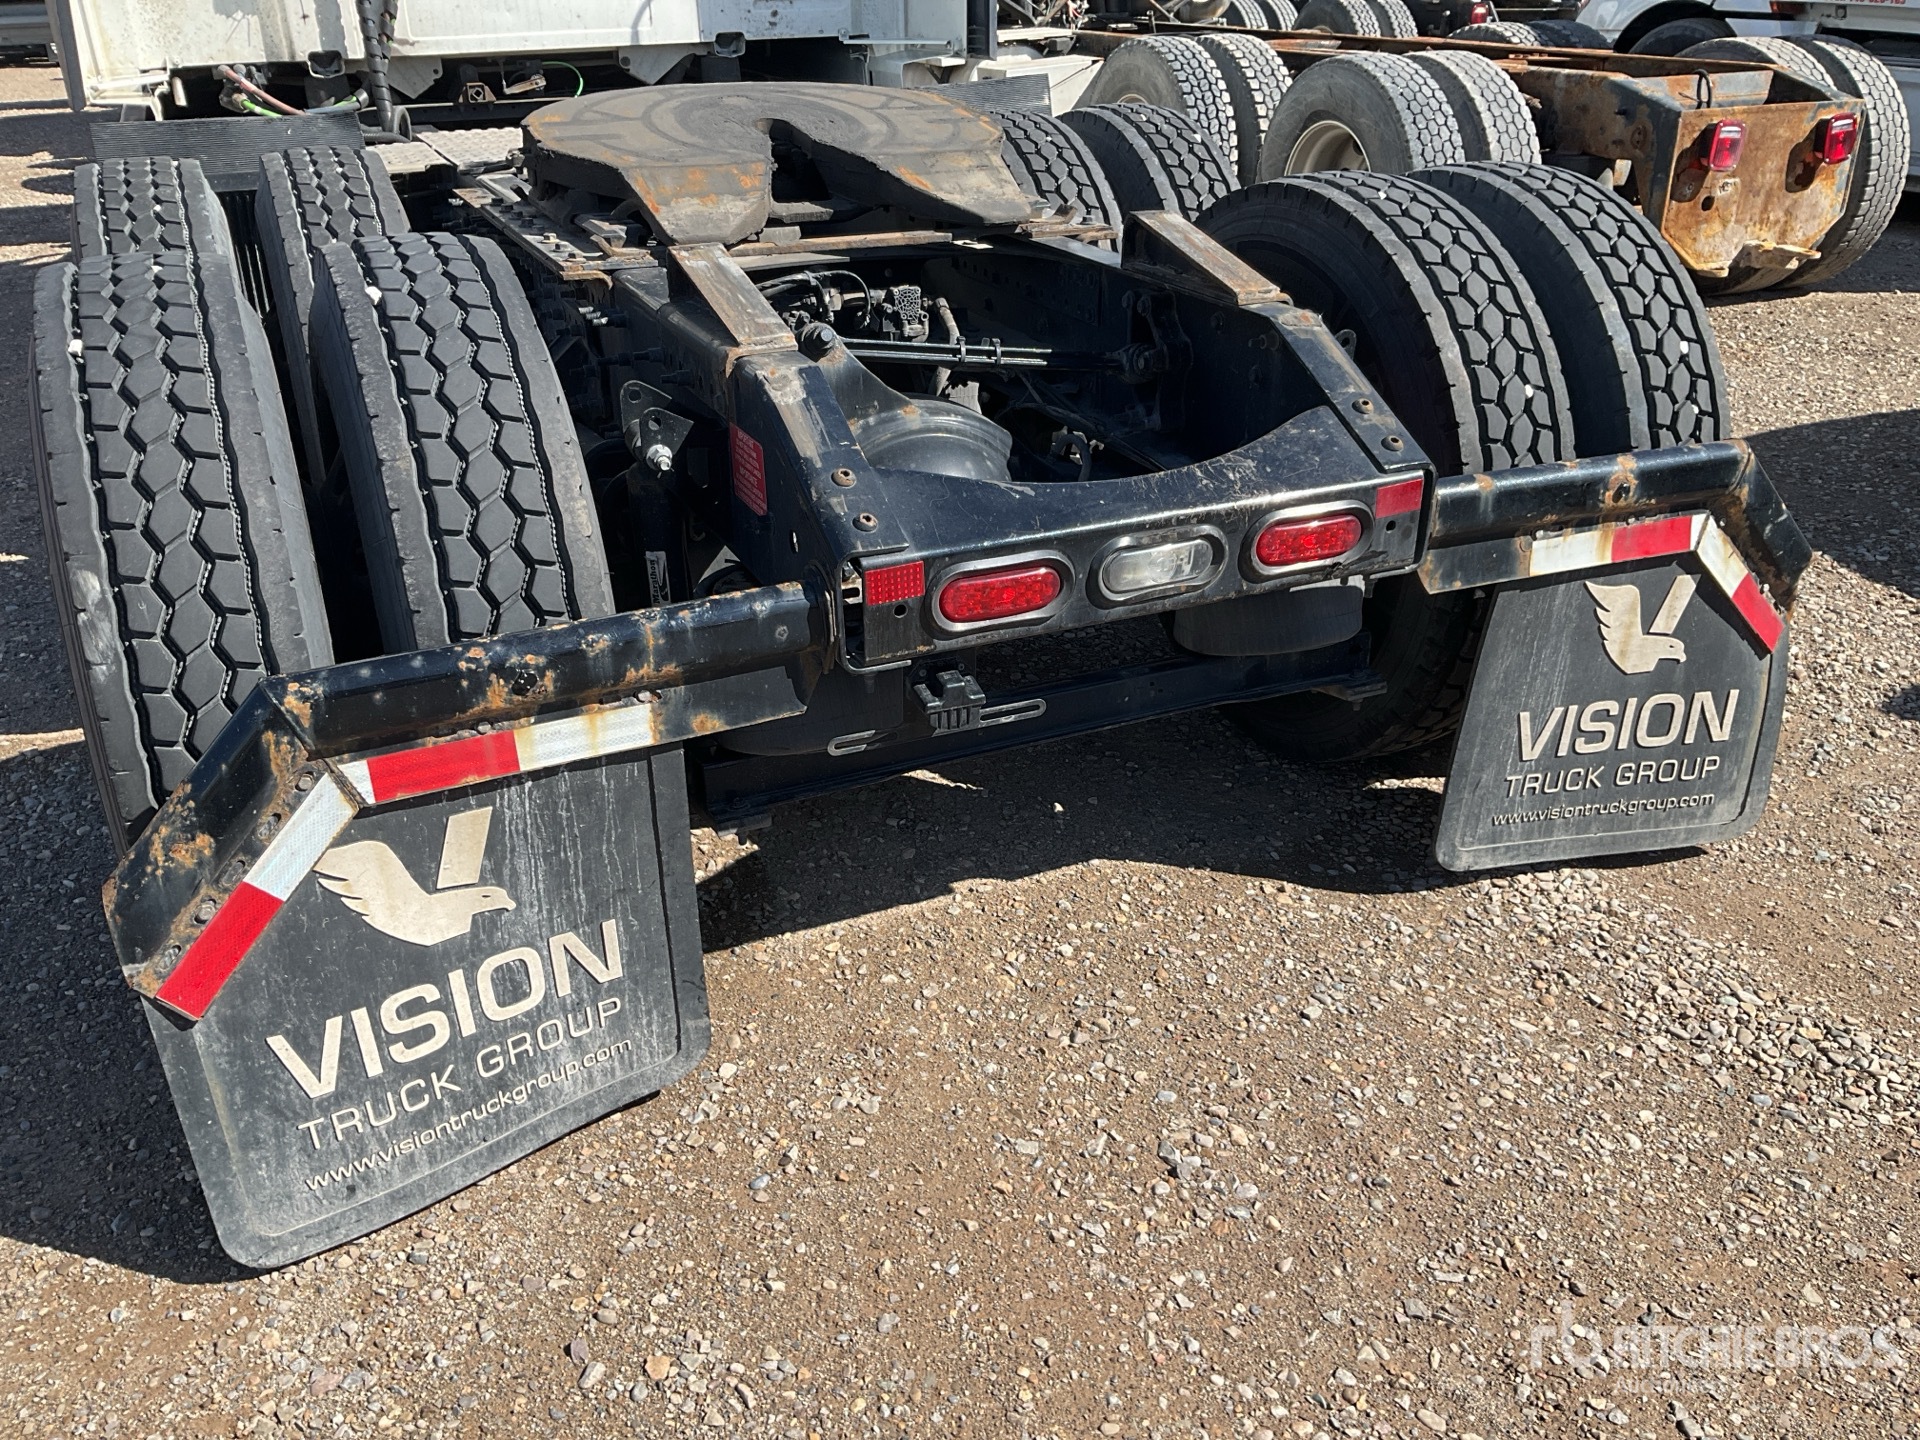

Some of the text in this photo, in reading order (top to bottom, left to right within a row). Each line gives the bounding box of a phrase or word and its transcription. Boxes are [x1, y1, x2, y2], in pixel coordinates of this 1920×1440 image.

[650, 560, 661, 604] Marathon
[1518, 688, 1741, 762] VISION
[1492, 792, 1715, 826] www.visiontruckgroup.com
[1506, 755, 1721, 798] TRUCK GROUP
[265, 918, 624, 1100] VISION
[298, 997, 622, 1151] TRUCK GROUP
[304, 1038, 633, 1191] www.visiontruckgroup.com
